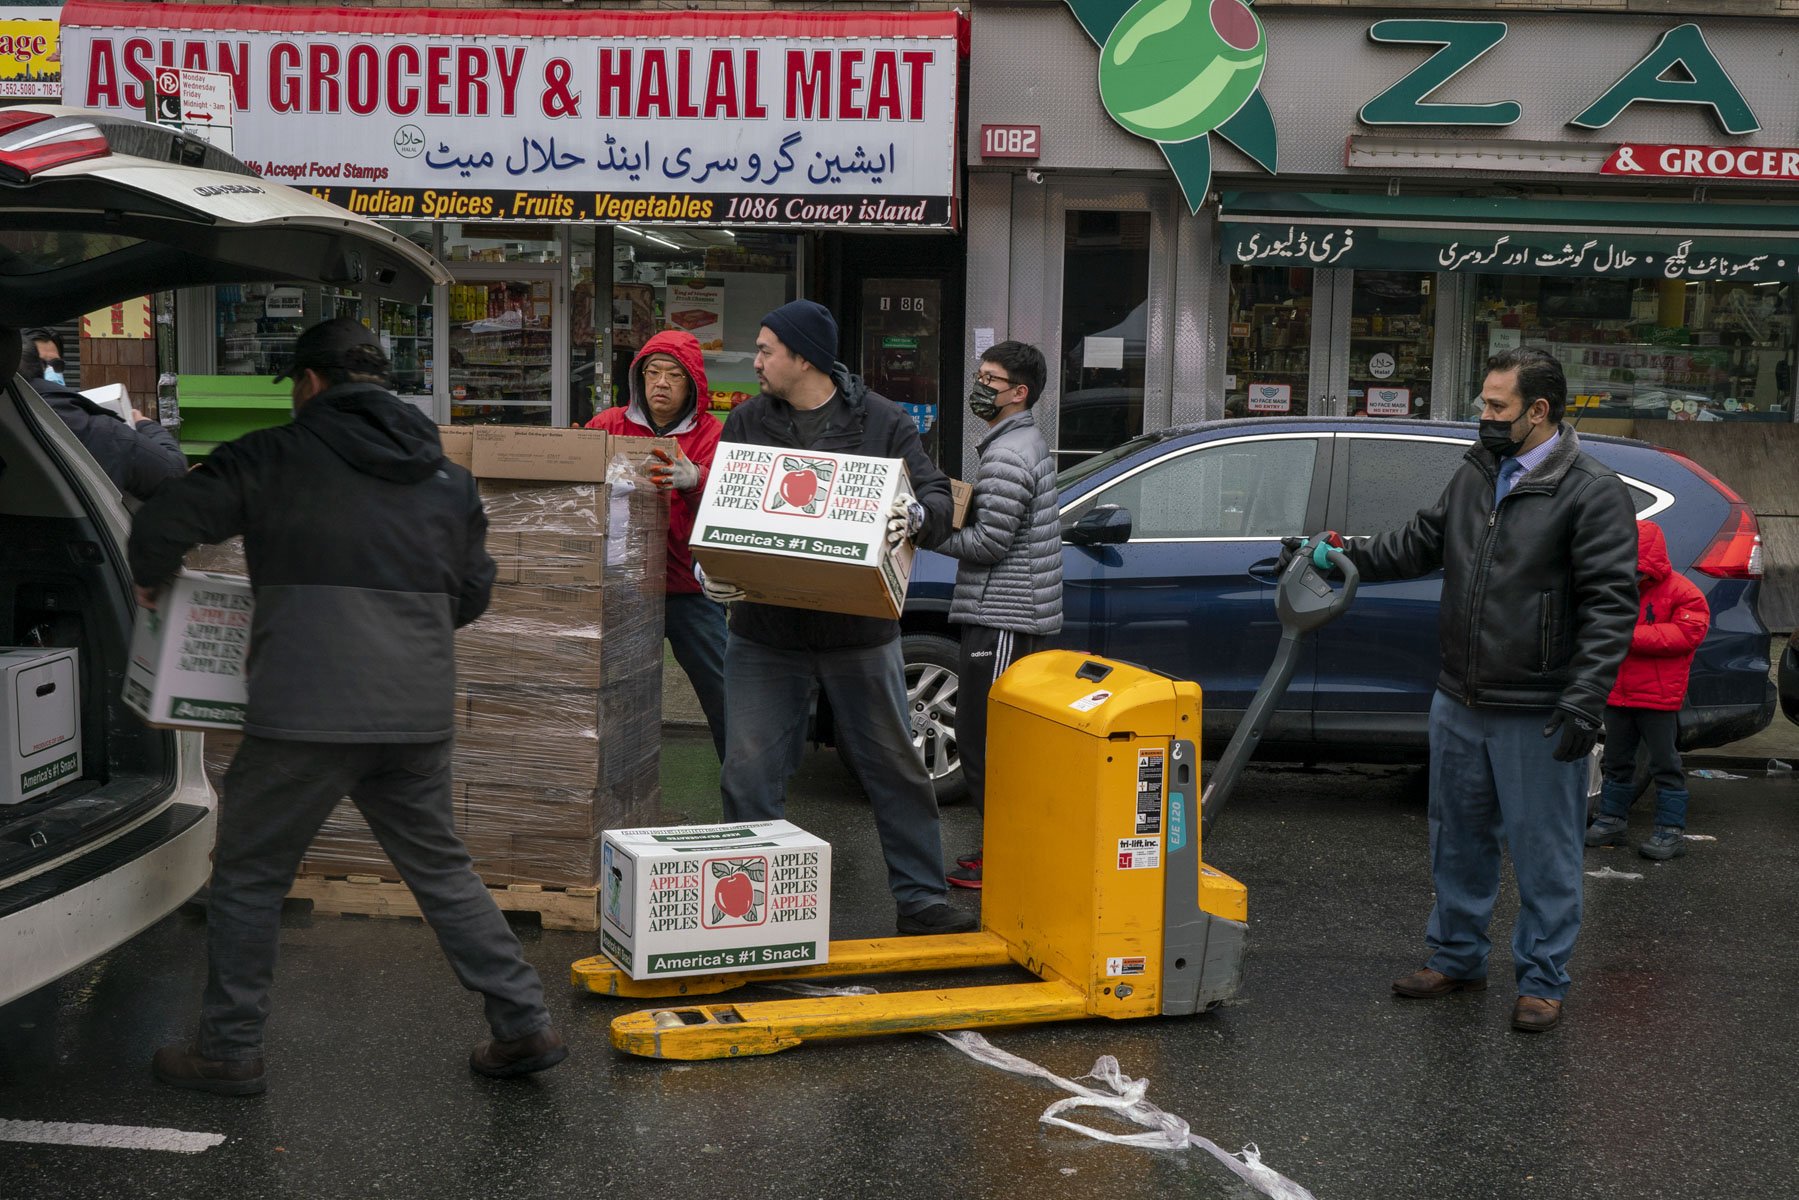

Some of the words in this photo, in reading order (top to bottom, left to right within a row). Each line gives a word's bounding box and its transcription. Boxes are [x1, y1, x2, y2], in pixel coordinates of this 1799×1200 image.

[182, 73, 205, 81] Monday
[268, 41, 529, 118] GROCERY
[540, 56, 582, 120] &
[597, 46, 768, 121] HALAL
[784, 48, 936, 122] MEAT
[183, 81, 216, 93] Wednesday
[183, 90, 201, 98] Friday
[183, 100, 208, 109] Midnight
[213, 102, 225, 110] 3am
[395, 129, 424, 148] حلال
[985, 129, 1036, 154] 1082
[425, 142, 494, 179] میٹ
[506, 136, 586, 175] حلال
[597, 133, 650, 182] اینڈ
[807, 142, 895, 185] ایشین
[1615, 146, 1644, 172] &
[1659, 148, 1799, 178] GROCER
[264, 161, 307, 180] Accept
[309, 162, 341, 179] Food
[343, 163, 389, 182] Stamps
[348, 188, 416, 214] Indian
[594, 193, 714, 223] Vegetables
[725, 196, 778, 220] 1086
[785, 198, 855, 225] Coney
[858, 199, 927, 222] island
[1503, 246, 1529, 266] اور
[1535, 239, 1598, 267] گوشت
[1594, 243, 1637, 272] حلال
[1371, 358, 1393, 368] حلال
[726, 450, 773, 463] APPLES
[722, 461, 770, 475] APPLES
[842, 461, 888, 475] APPLES
[719, 472, 766, 487] APPLES
[838, 473, 885, 487] APPLES
[716, 484, 762, 499] APPLES
[834, 485, 881, 499] APPLES
[712, 496, 759, 511] APPLES
[830, 497, 879, 511] APPLES
[827, 509, 875, 523] APPLES
[708, 529, 785, 548] America's
[788, 537, 807, 550] #1
[811, 540, 861, 558] Snack
[23, 766, 53, 789] America's
[52, 763, 60, 776] #1
[60, 756, 77, 773] Snack
[1171, 801, 1182, 823] 120
[1144, 839, 1159, 848] inc.
[1171, 826, 1181, 845] EJE
[771, 852, 818, 867] APPLES
[649, 860, 699, 876] APPLES
[771, 866, 818, 882] APPLES
[649, 874, 699, 890] APPLES
[771, 880, 818, 895] APPLES
[649, 888, 699, 904] APPLES
[770, 894, 817, 910] APPLES
[649, 902, 699, 918] APPLES
[770, 908, 817, 923] APPLES
[648, 916, 698, 932] APPLES
[654, 952, 735, 970] America's
[739, 950, 756, 964] #1
[762, 946, 809, 961] Snack
